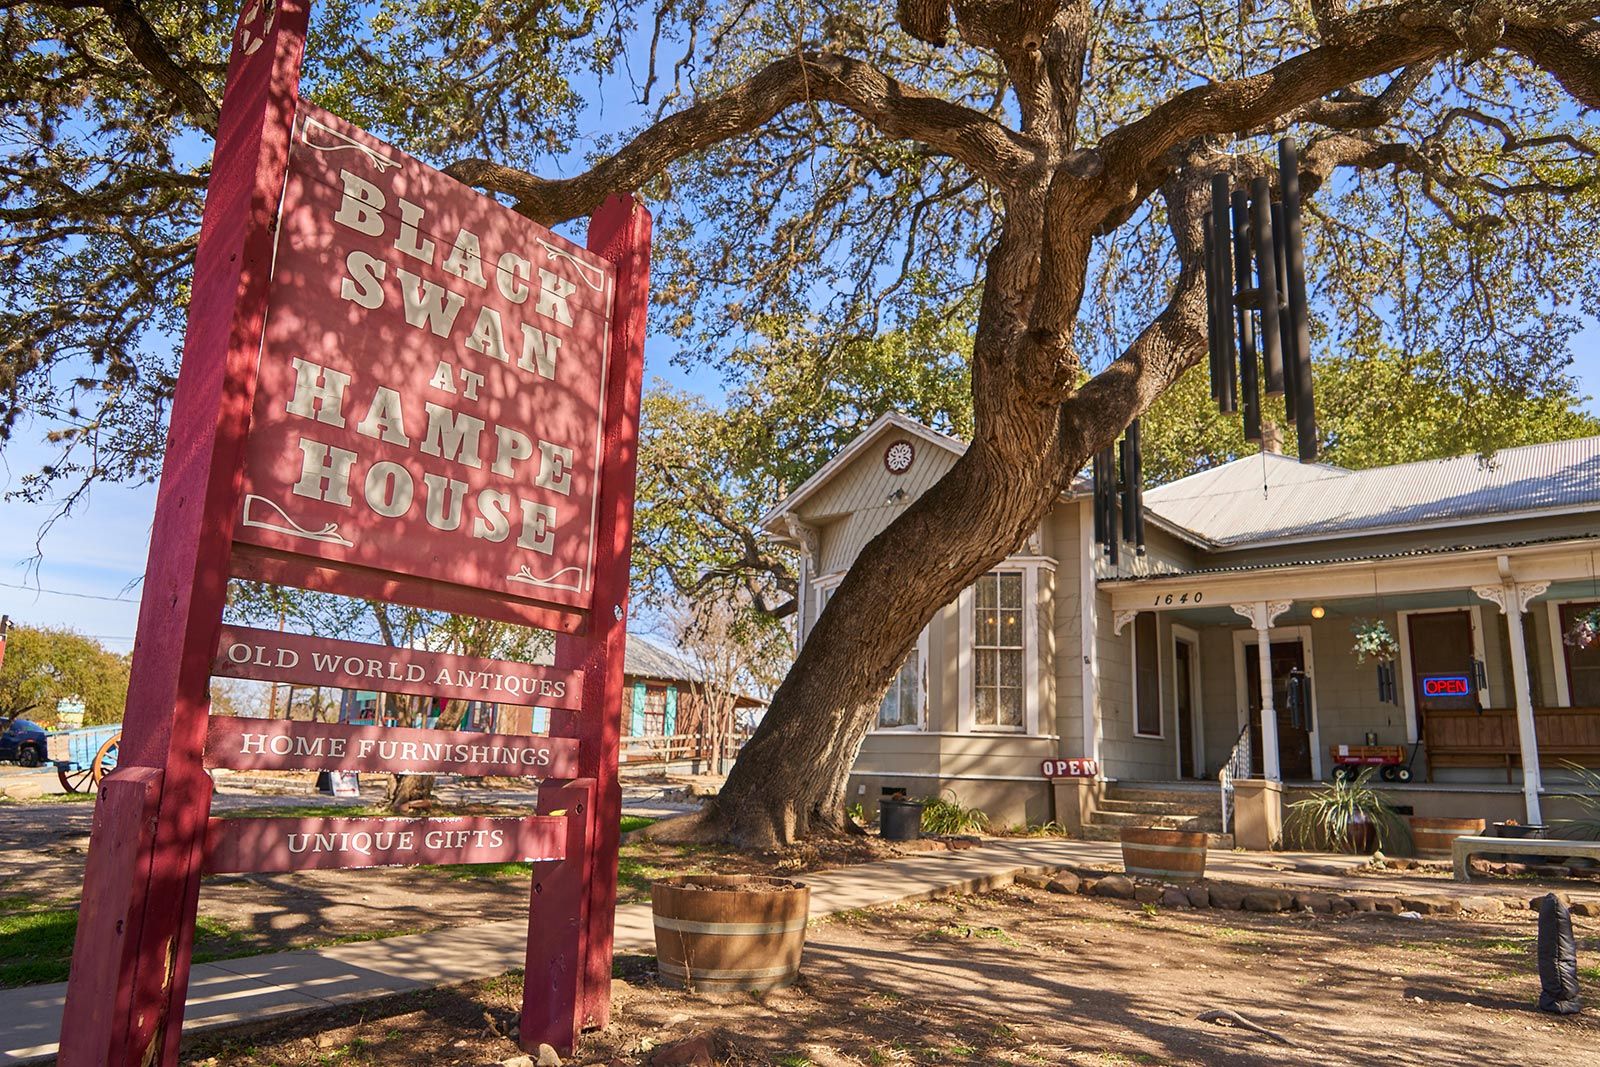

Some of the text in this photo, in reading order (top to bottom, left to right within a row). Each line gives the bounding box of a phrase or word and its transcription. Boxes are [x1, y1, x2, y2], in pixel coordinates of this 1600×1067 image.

[334, 168, 577, 328] BLACK
[340, 251, 562, 381] SWAN
[429, 361, 485, 401] AT
[286, 357, 574, 496] HAMPE
[293, 437, 557, 556] HOUSE
[1154, 592, 1203, 606] 1640
[228, 643, 566, 698] OLD WORLD ANTIQUES
[1426, 680, 1466, 693] OPEN
[240, 733, 550, 767] HOME FURNISHINGS
[1043, 761, 1097, 776] OPEN
[287, 829, 505, 856] UNIQUE GIFTS
